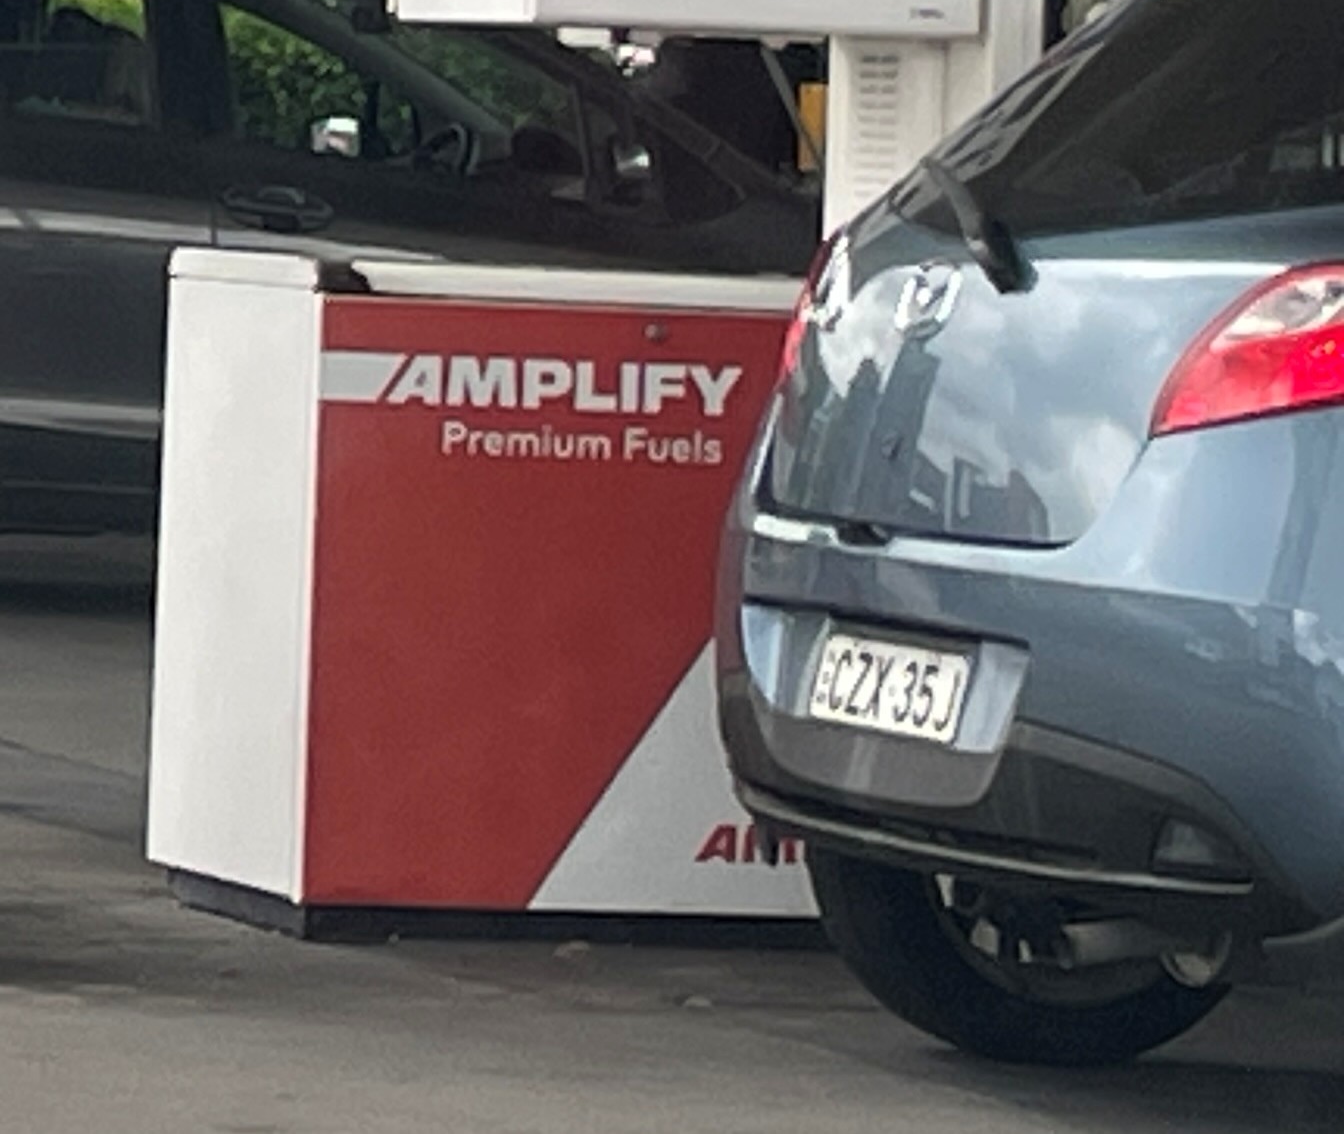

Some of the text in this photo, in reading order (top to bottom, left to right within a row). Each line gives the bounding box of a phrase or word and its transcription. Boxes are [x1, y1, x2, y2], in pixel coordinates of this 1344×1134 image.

[386, 353, 743, 417] AMPLIFY
[441, 420, 722, 466] Premium Fuels
